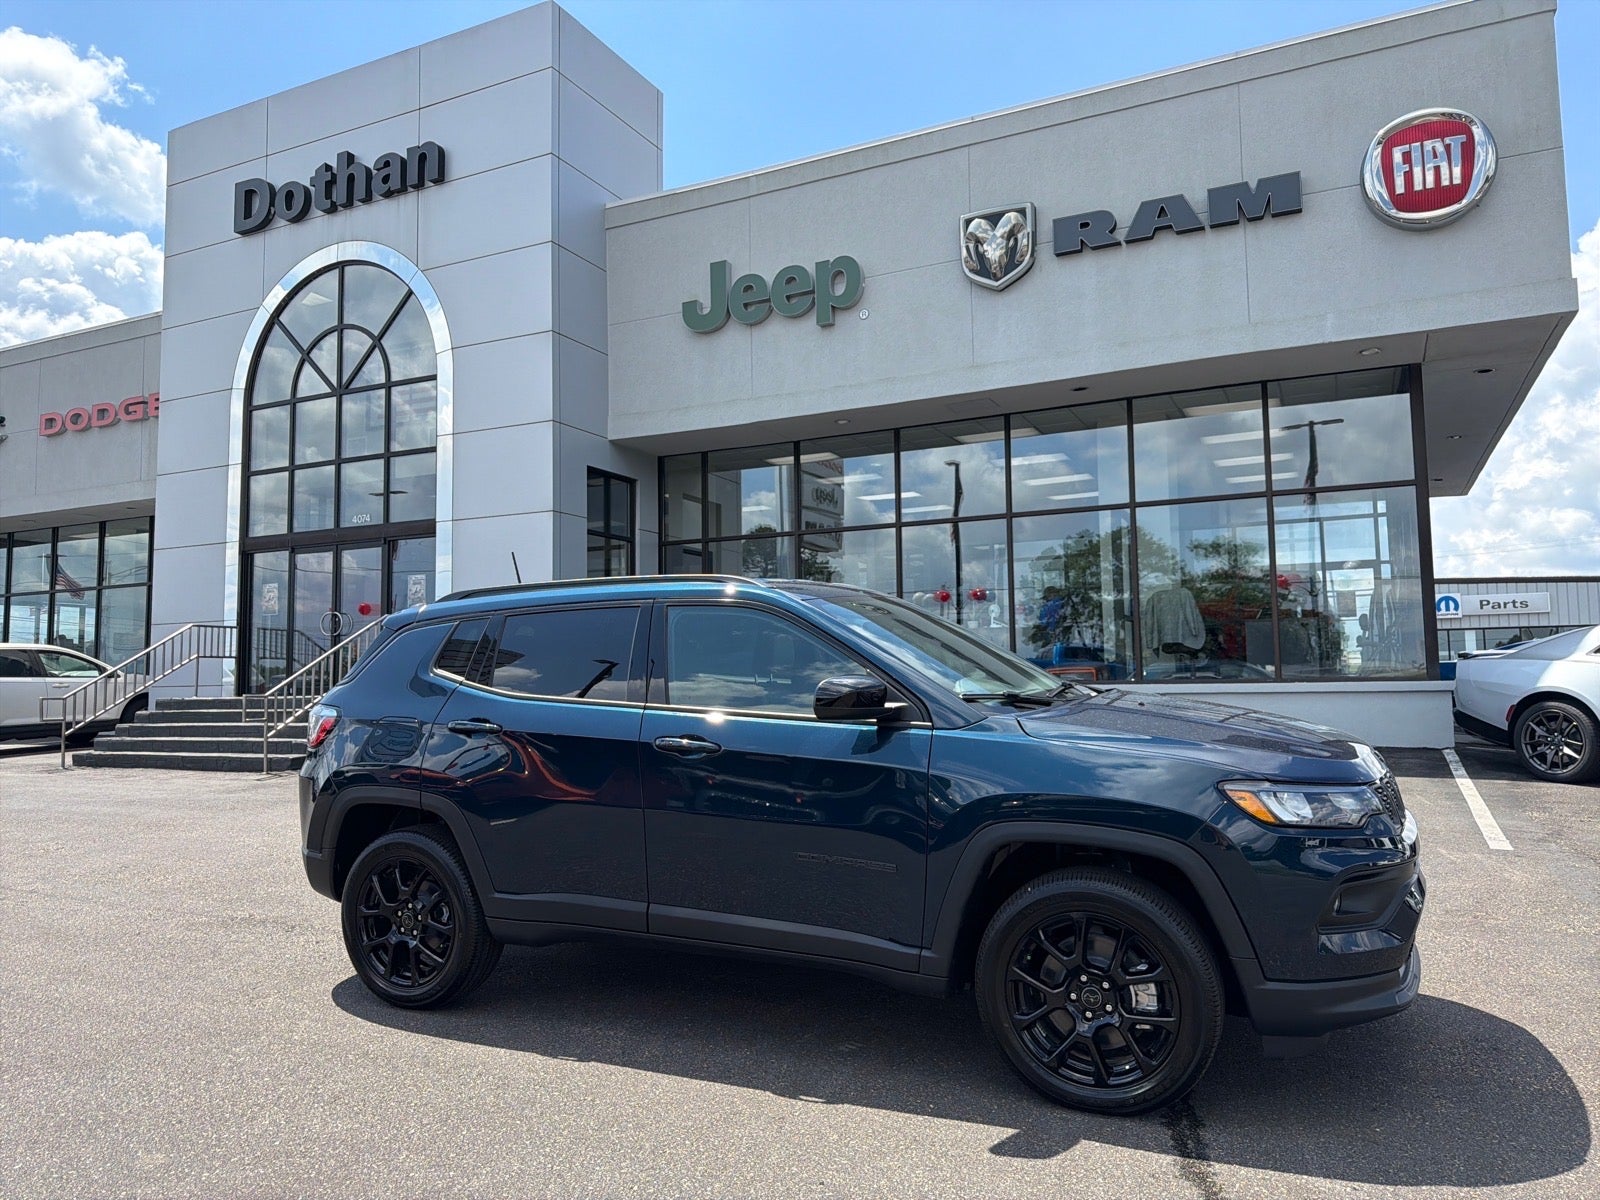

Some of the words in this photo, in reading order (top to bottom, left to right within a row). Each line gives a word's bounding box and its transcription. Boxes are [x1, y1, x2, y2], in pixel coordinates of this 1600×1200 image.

[233, 140, 446, 236] Dothan
[1393, 134, 1468, 196] FIAT
[1052, 170, 1303, 258] RAM
[681, 255, 866, 334] Jeep
[351, 513, 371, 524] 4074
[1479, 598, 1530, 610] Parts
